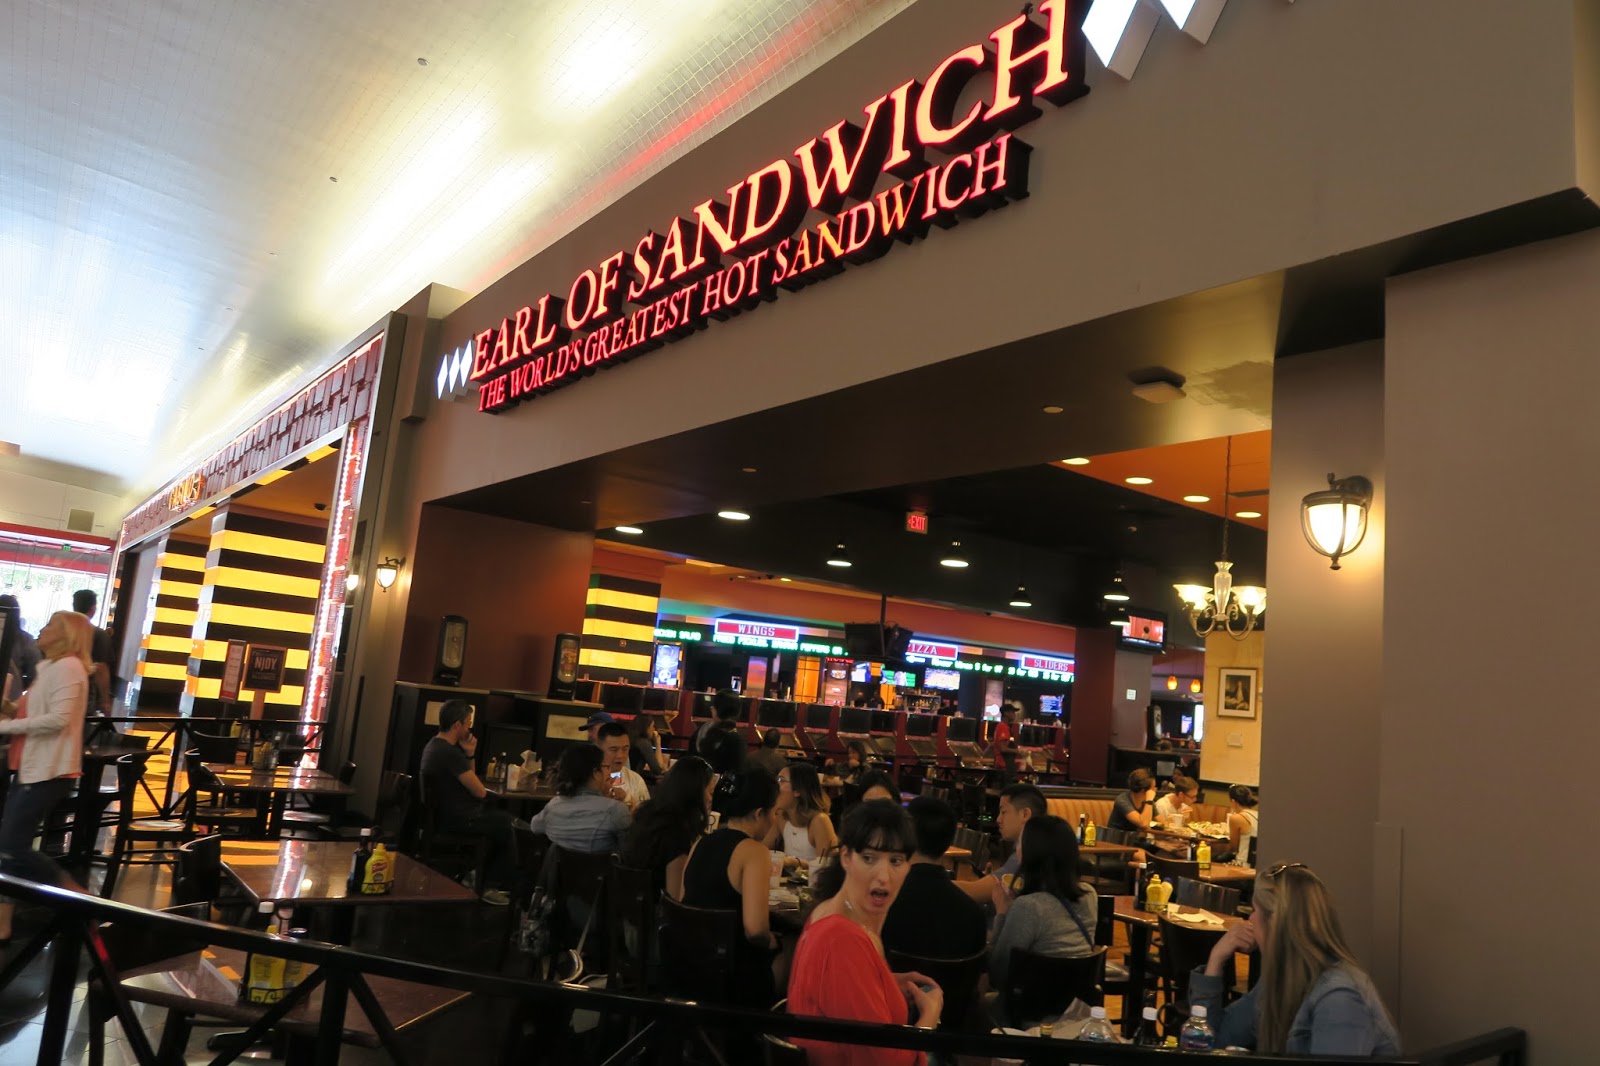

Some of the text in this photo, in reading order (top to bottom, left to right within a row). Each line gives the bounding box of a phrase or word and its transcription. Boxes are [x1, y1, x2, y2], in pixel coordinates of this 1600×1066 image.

[469, 0, 1069, 381] EARL OF SANDWICH
[478, 133, 1012, 412] THE WORLD'S GREATEST HOT SANDWICH
[910, 514, 926, 531] EXIT
[738, 624, 776, 637] WINGS
[254, 656, 278, 671] NJOY
[1034, 659, 1069, 672] SLIDERS
